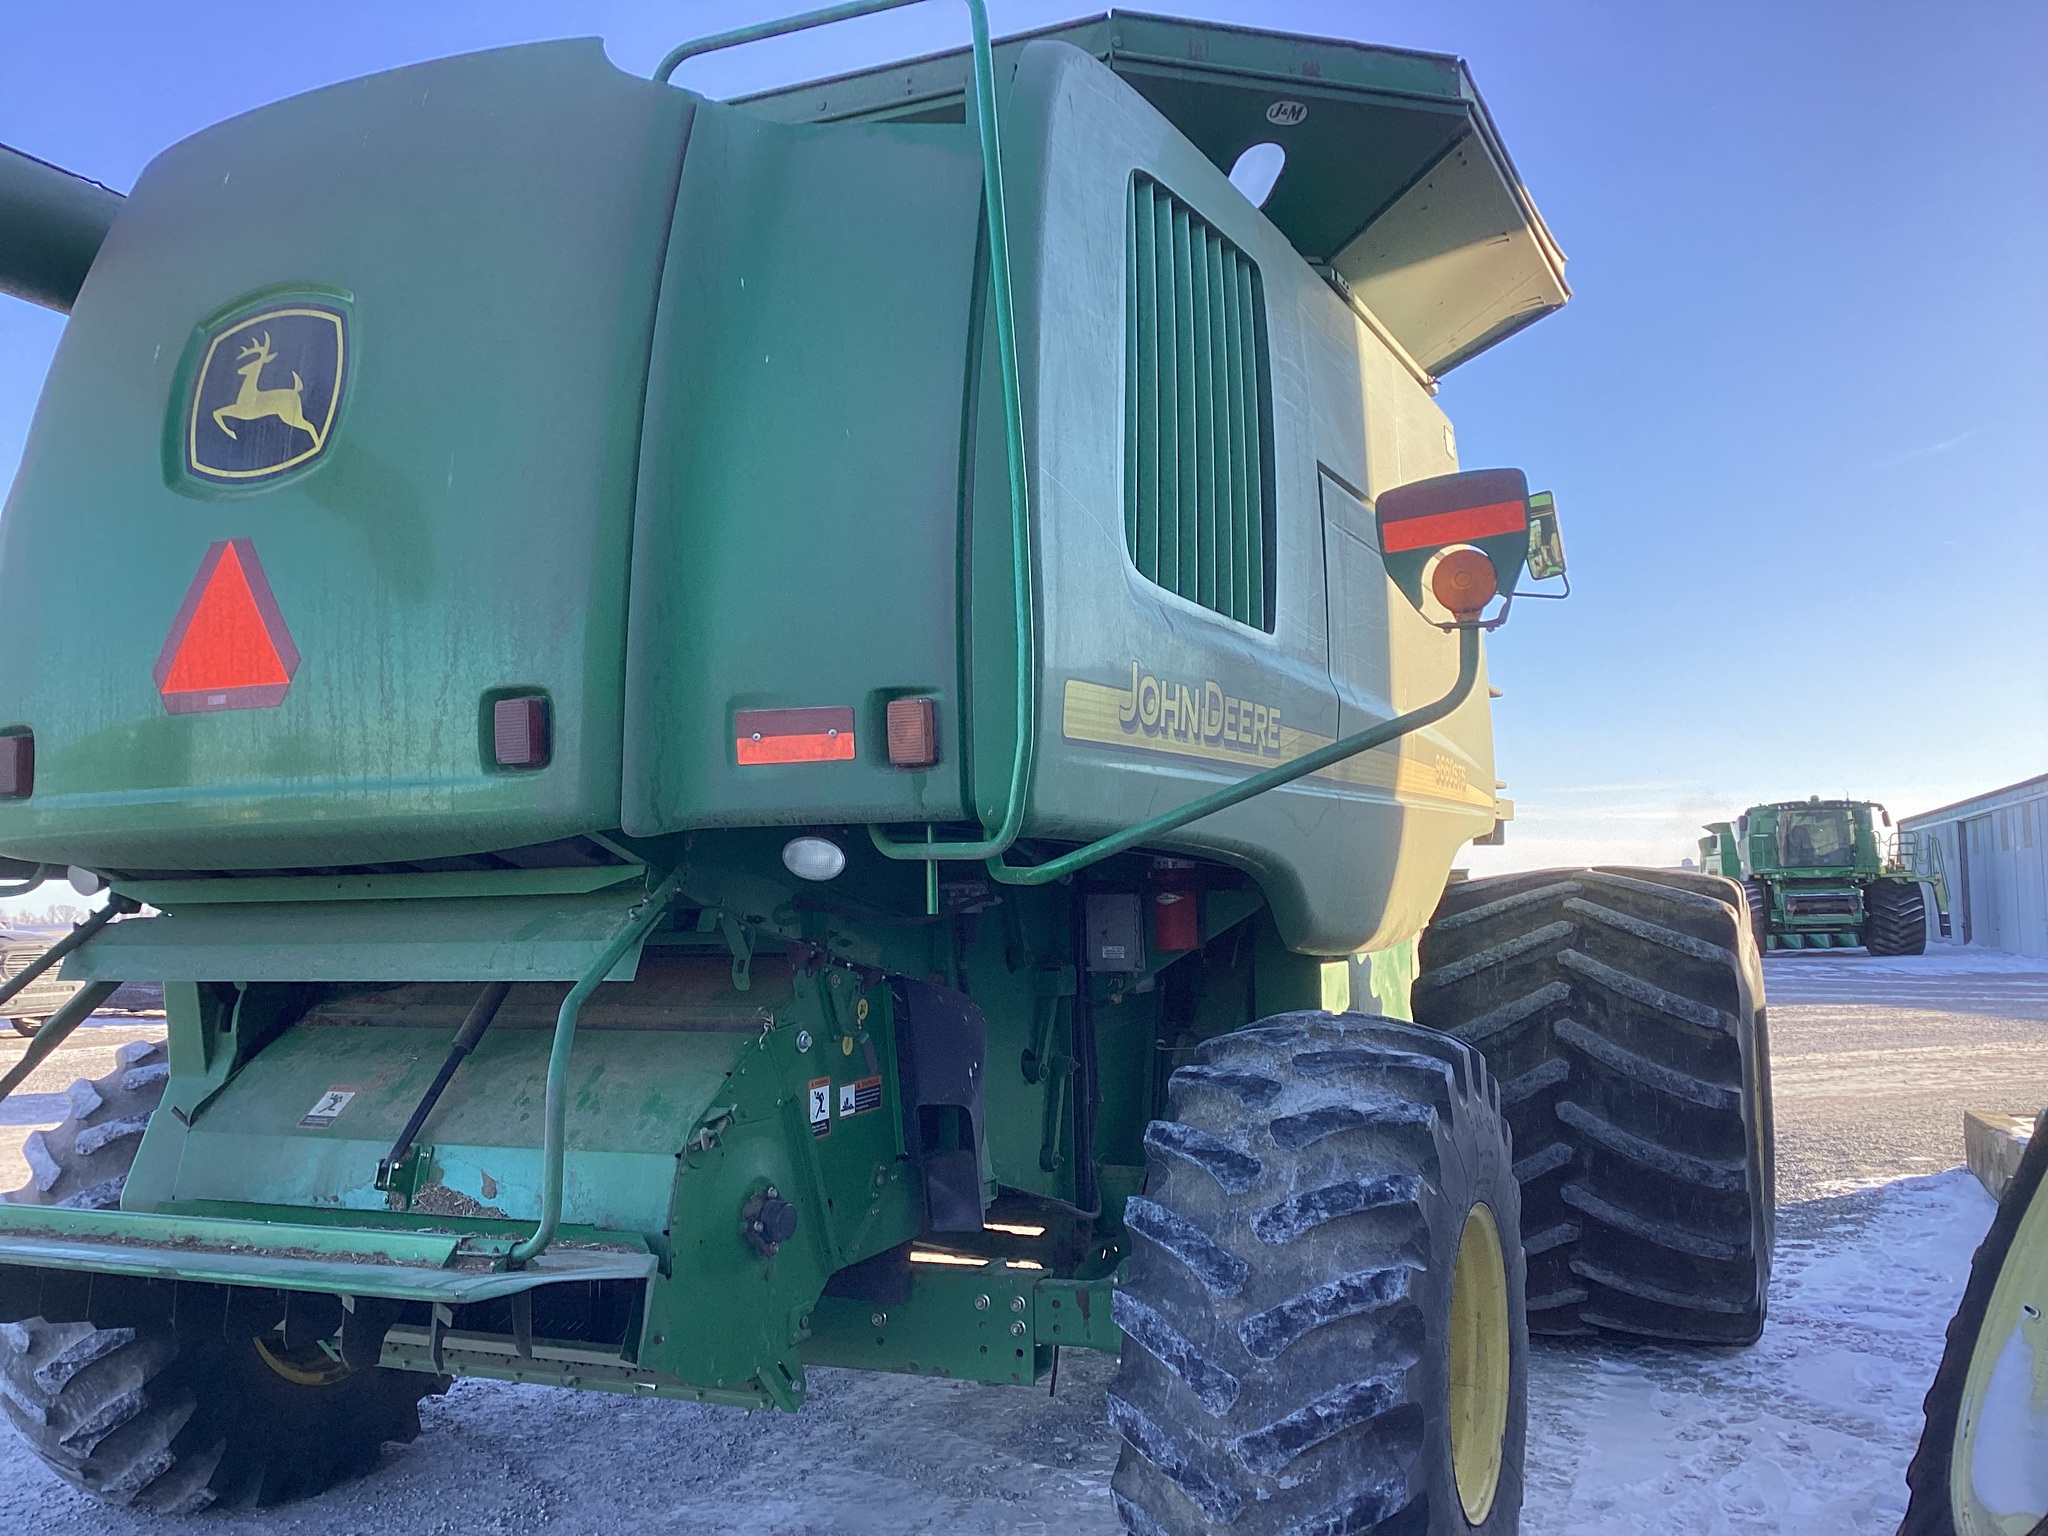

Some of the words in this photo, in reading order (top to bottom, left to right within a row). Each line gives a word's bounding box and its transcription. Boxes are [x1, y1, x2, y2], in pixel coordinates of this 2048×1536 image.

[1269, 103, 1304, 120] J&M
[1119, 661, 1201, 744] JOHN
[1202, 680, 1281, 757] DEERE
